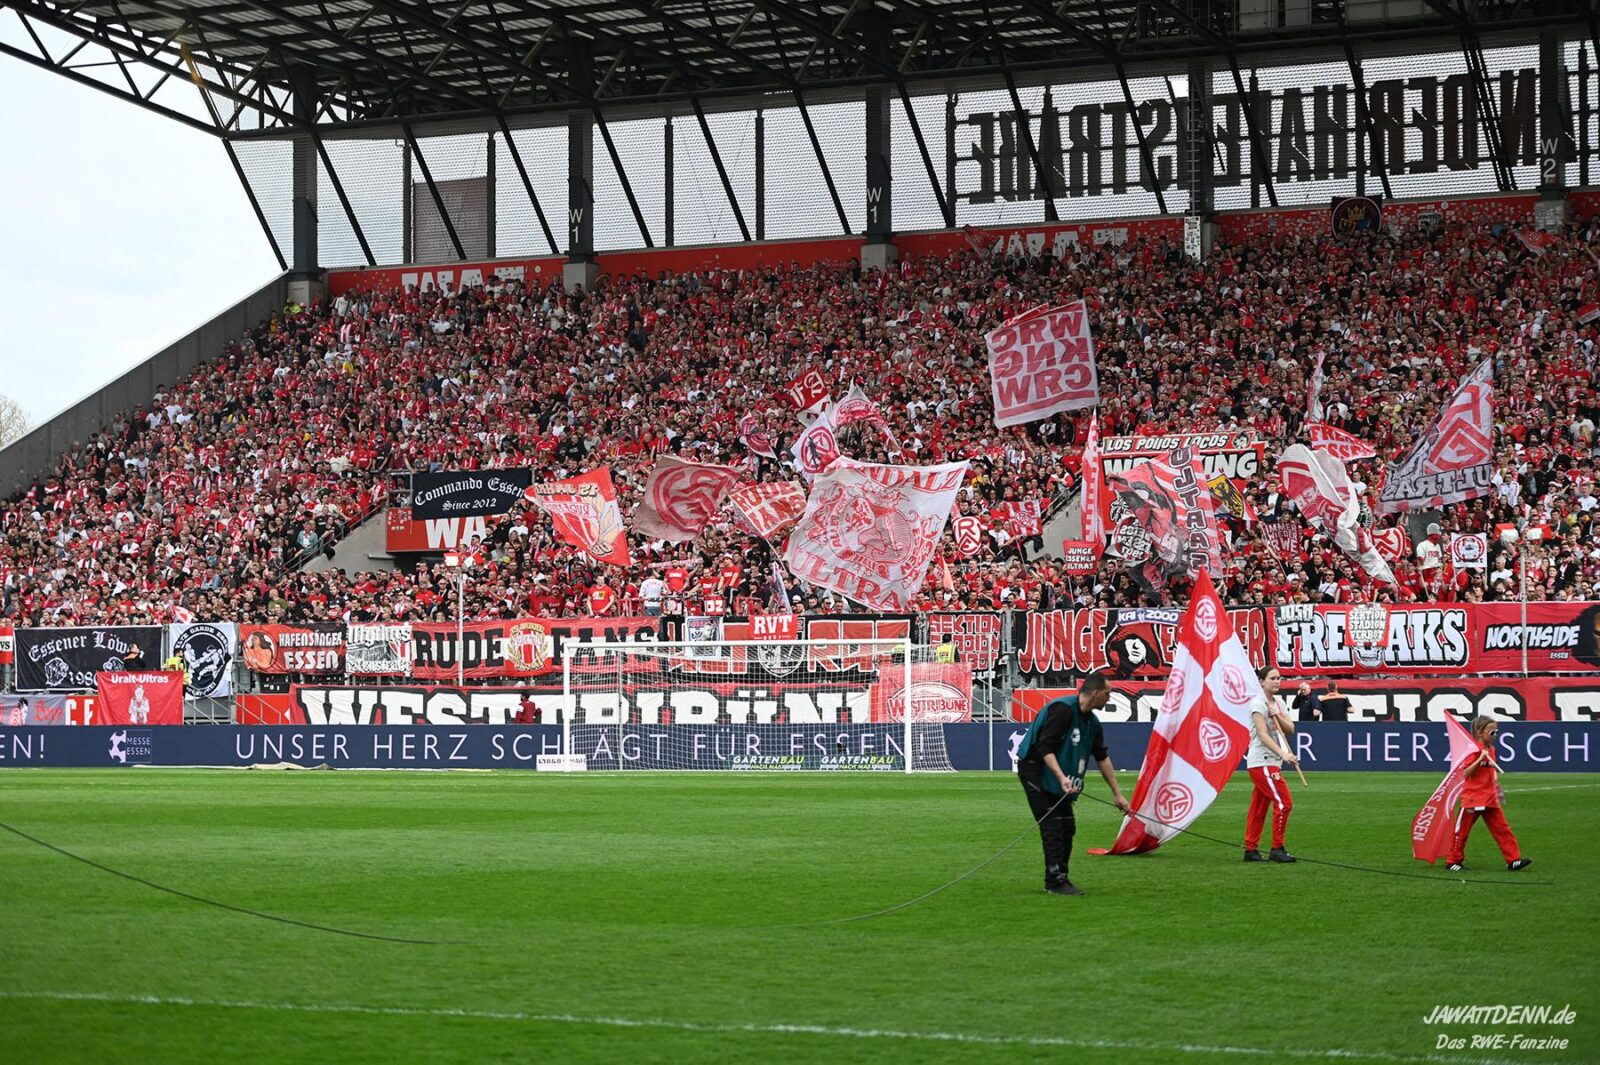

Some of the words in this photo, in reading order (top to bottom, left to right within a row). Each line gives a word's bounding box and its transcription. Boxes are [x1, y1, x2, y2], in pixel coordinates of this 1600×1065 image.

[1540, 137, 1559, 155] W
[866, 186, 883, 203] W
[569, 208, 584, 223] W
[1106, 438, 1132, 451] LOS
[414, 478, 483, 506] Commando
[487, 476, 526, 498] Essen
[442, 498, 471, 512] Since
[472, 497, 497, 509] 2012
[1068, 547, 1093, 555] JUNGE
[1117, 610, 1137, 622] KAI
[1145, 609, 1179, 622] 2000
[1348, 610, 1387, 620] SEKTION
[753, 615, 793, 635] RVT
[929, 614, 1001, 633] SEKTION
[1348, 620, 1386, 630] STADION
[1017, 608, 1109, 674] JUNGE
[1486, 625, 1580, 649] NORTHSIDE
[28, 635, 88, 662] Essener
[413, 628, 504, 669] RUDE
[284, 651, 339, 670] ESSEN
[111, 674, 169, 685] Uralt-Ultras
[126, 737, 151, 745] MESSE
[236, 733, 350, 760] UNSER
[374, 733, 468, 760] HERZ
[693, 728, 761, 760] FÜR
[126, 747, 151, 755] ESSEN
[733, 755, 804, 764] GARTENBAU
[822, 755, 894, 764] GARTENBAU
[1413, 805, 1437, 841] ESSEN
